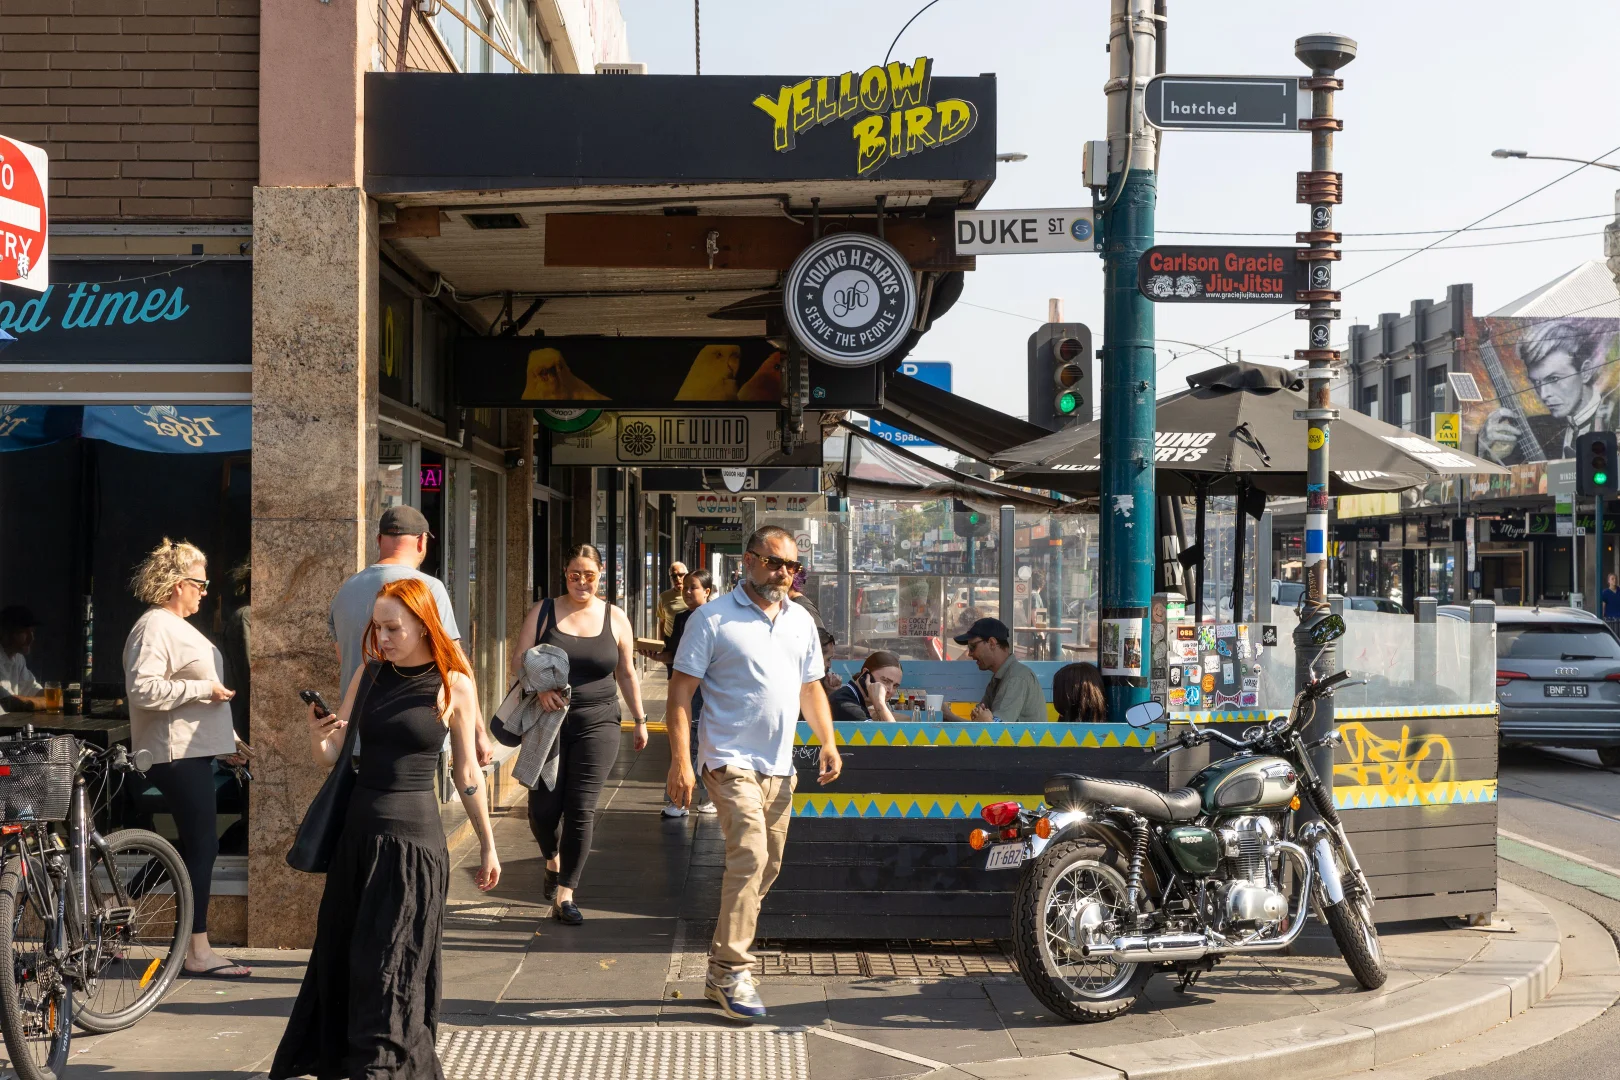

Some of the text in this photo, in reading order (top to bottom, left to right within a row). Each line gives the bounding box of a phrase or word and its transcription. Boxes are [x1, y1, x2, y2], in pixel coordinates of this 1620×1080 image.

[752, 56, 931, 152] YELLOW
[1170, 101, 1238, 115] hatched
[853, 99, 975, 175] BIRD
[957, 217, 1065, 245] DUKE ST
[803, 248, 900, 295] YOUNG HENRYS
[1149, 252, 1284, 272] Carlson Gracie
[1205, 274, 1283, 292] Jiu-Jitsu
[1205, 291, 1283, 300] www.graciejiujitsu.com.au
[61, 281, 190, 329] times
[804, 304, 896, 347] SERVE THE PEOPLE
